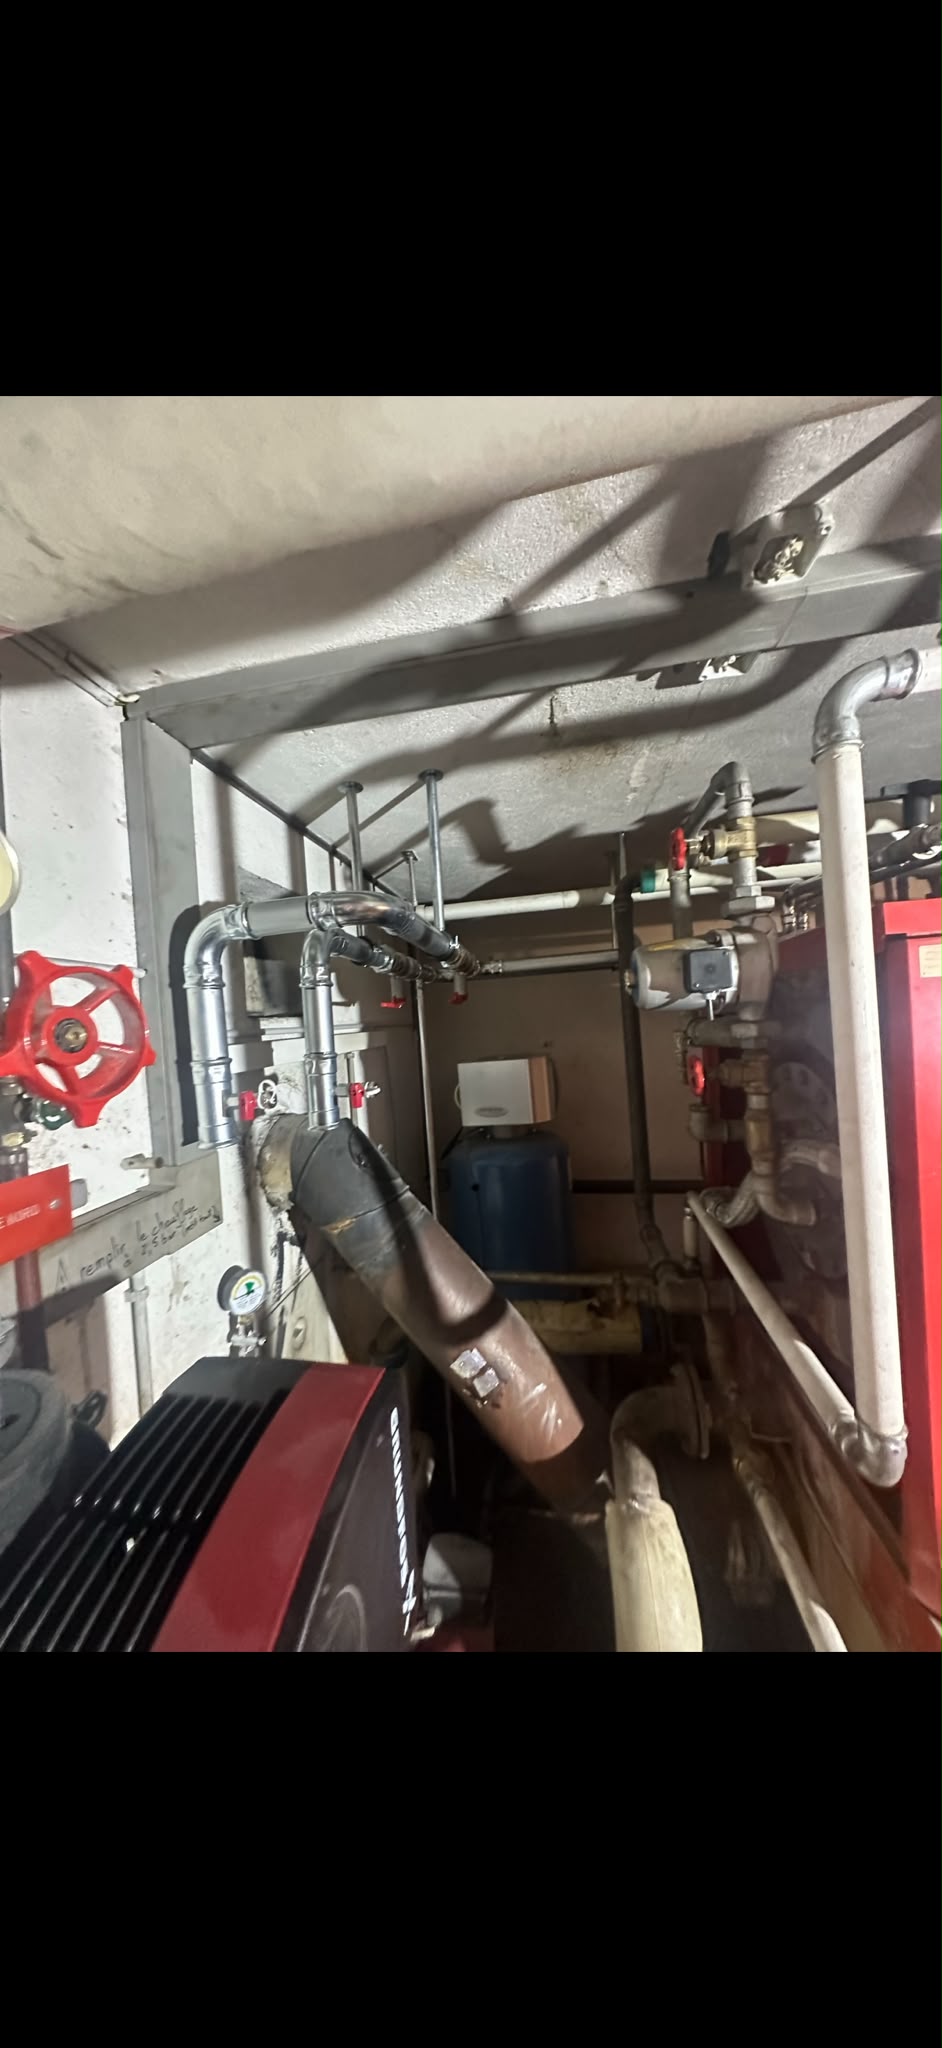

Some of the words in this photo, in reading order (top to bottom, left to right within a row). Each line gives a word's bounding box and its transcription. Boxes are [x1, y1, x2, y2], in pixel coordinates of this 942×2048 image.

[80, 1236, 126, 1281] remplir
[135, 1220, 149, 1241] le
[152, 1198, 198, 1236] chauffage
[390, 1407, 408, 1588] GRUNDFOS
